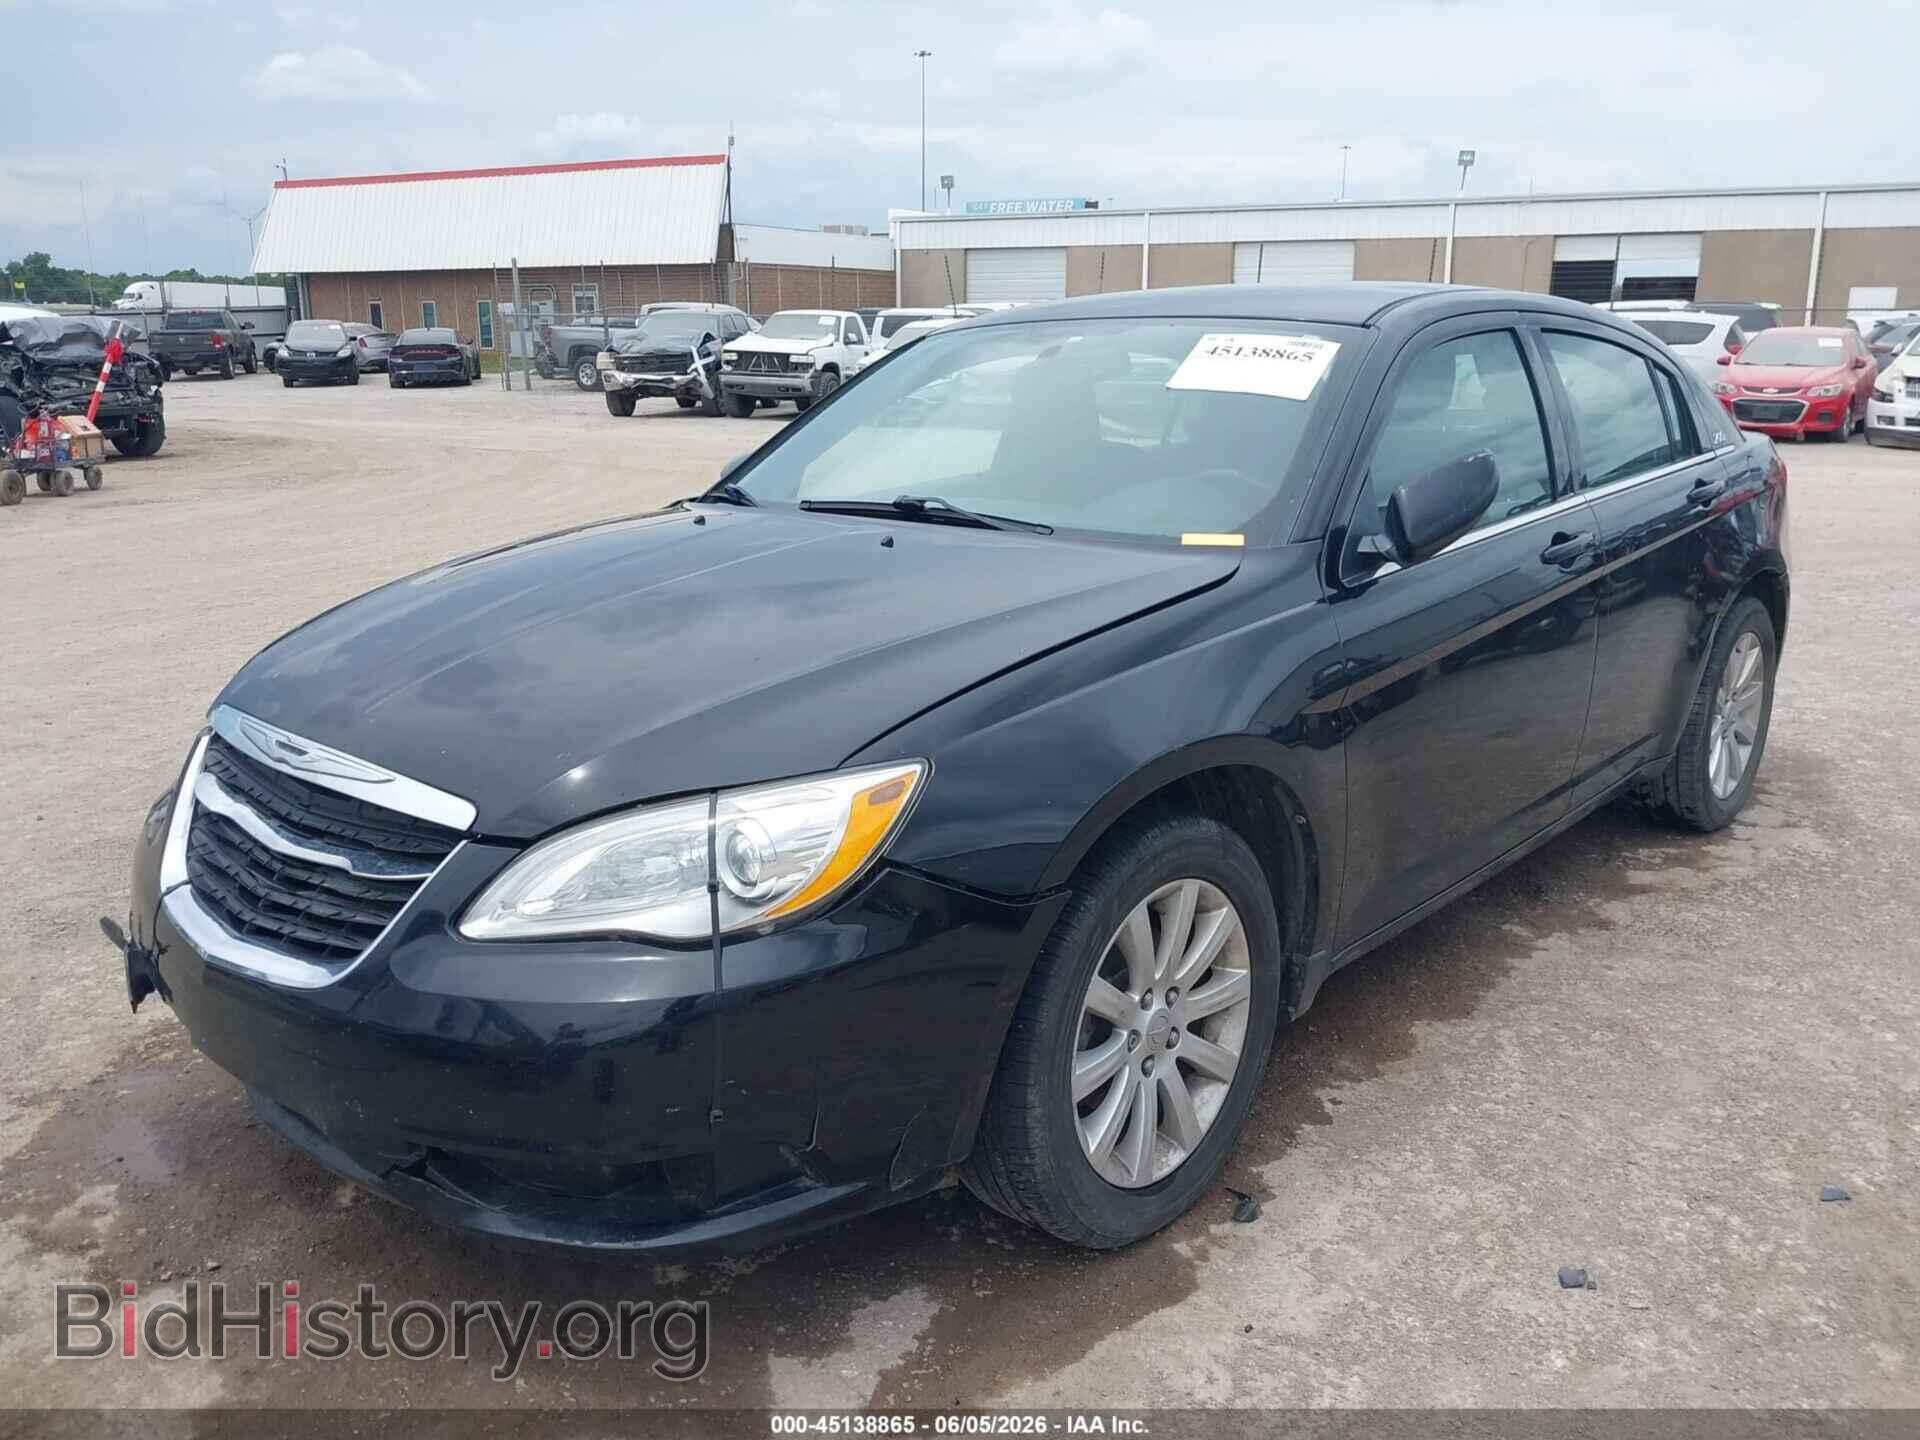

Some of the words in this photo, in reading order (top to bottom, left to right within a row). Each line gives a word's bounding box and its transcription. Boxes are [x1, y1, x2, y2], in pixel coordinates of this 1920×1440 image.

[990, 201, 1023, 214] FREE
[1026, 200, 1074, 213] WATER
[1205, 345, 1316, 362] 45138865
